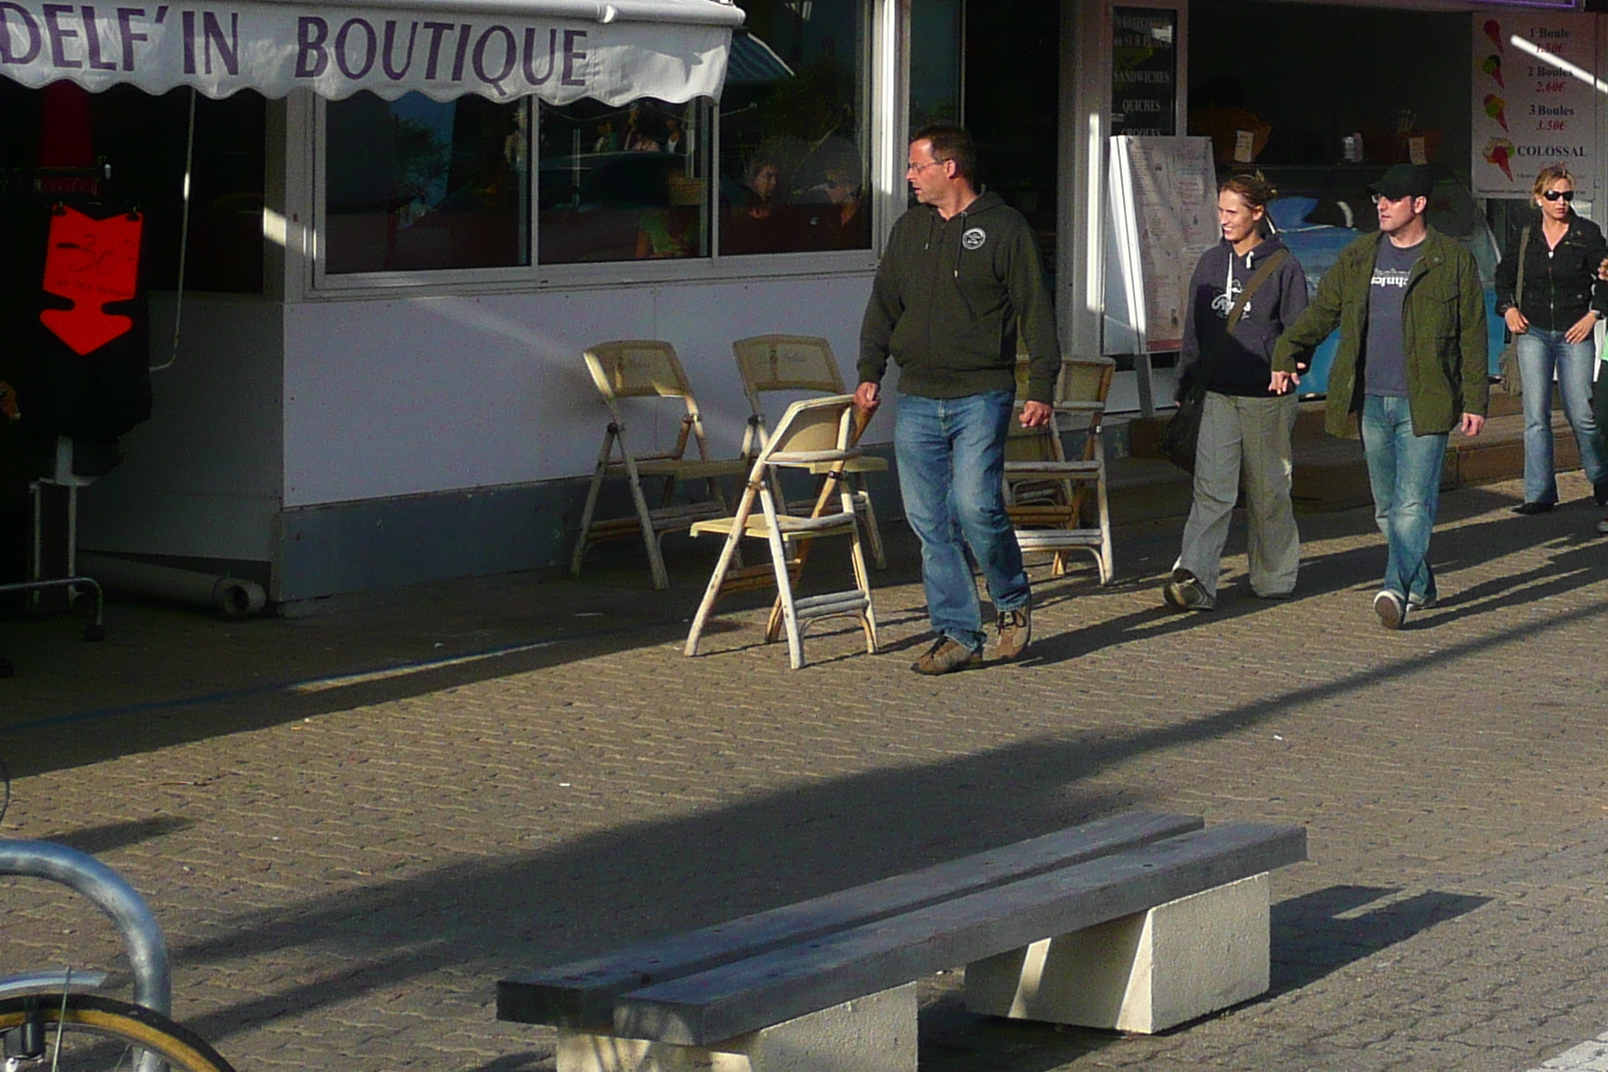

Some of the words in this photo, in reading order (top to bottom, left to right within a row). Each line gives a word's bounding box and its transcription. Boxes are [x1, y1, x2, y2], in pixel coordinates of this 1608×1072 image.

[1539, 28, 1570, 39] Boule
[295, 14, 589, 96] BOUTIQUE
[1527, 66, 1534, 77] 2
[1537, 66, 1574, 78] Boules
[1529, 104, 1536, 115] 3
[1538, 104, 1575, 116] Boules
[1517, 145, 1587, 157] COLOSSAL
